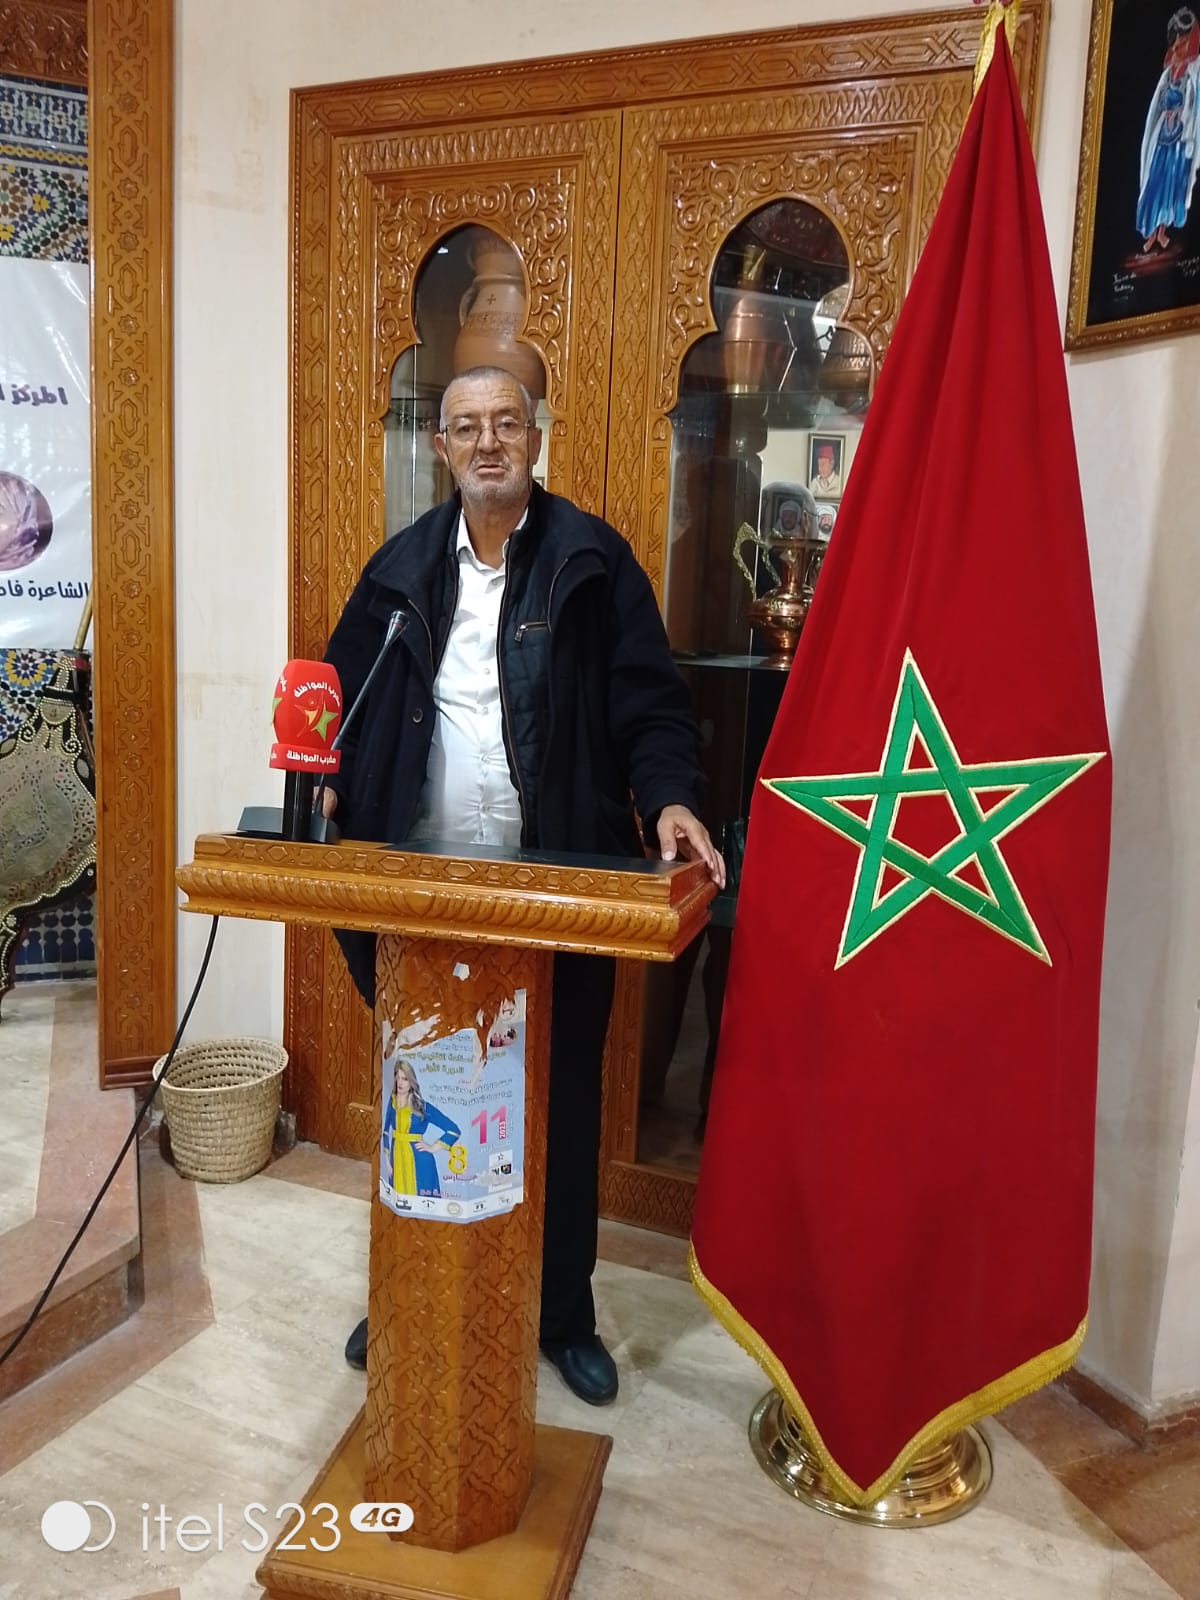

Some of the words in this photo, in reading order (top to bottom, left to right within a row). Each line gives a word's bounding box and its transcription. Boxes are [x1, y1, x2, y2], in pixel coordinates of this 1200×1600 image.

[28, 580, 88, 601] الشاعرة
[286, 750, 320, 763] المواطنة
[470, 1105, 507, 1145] 11
[448, 1144, 467, 1175] 8
